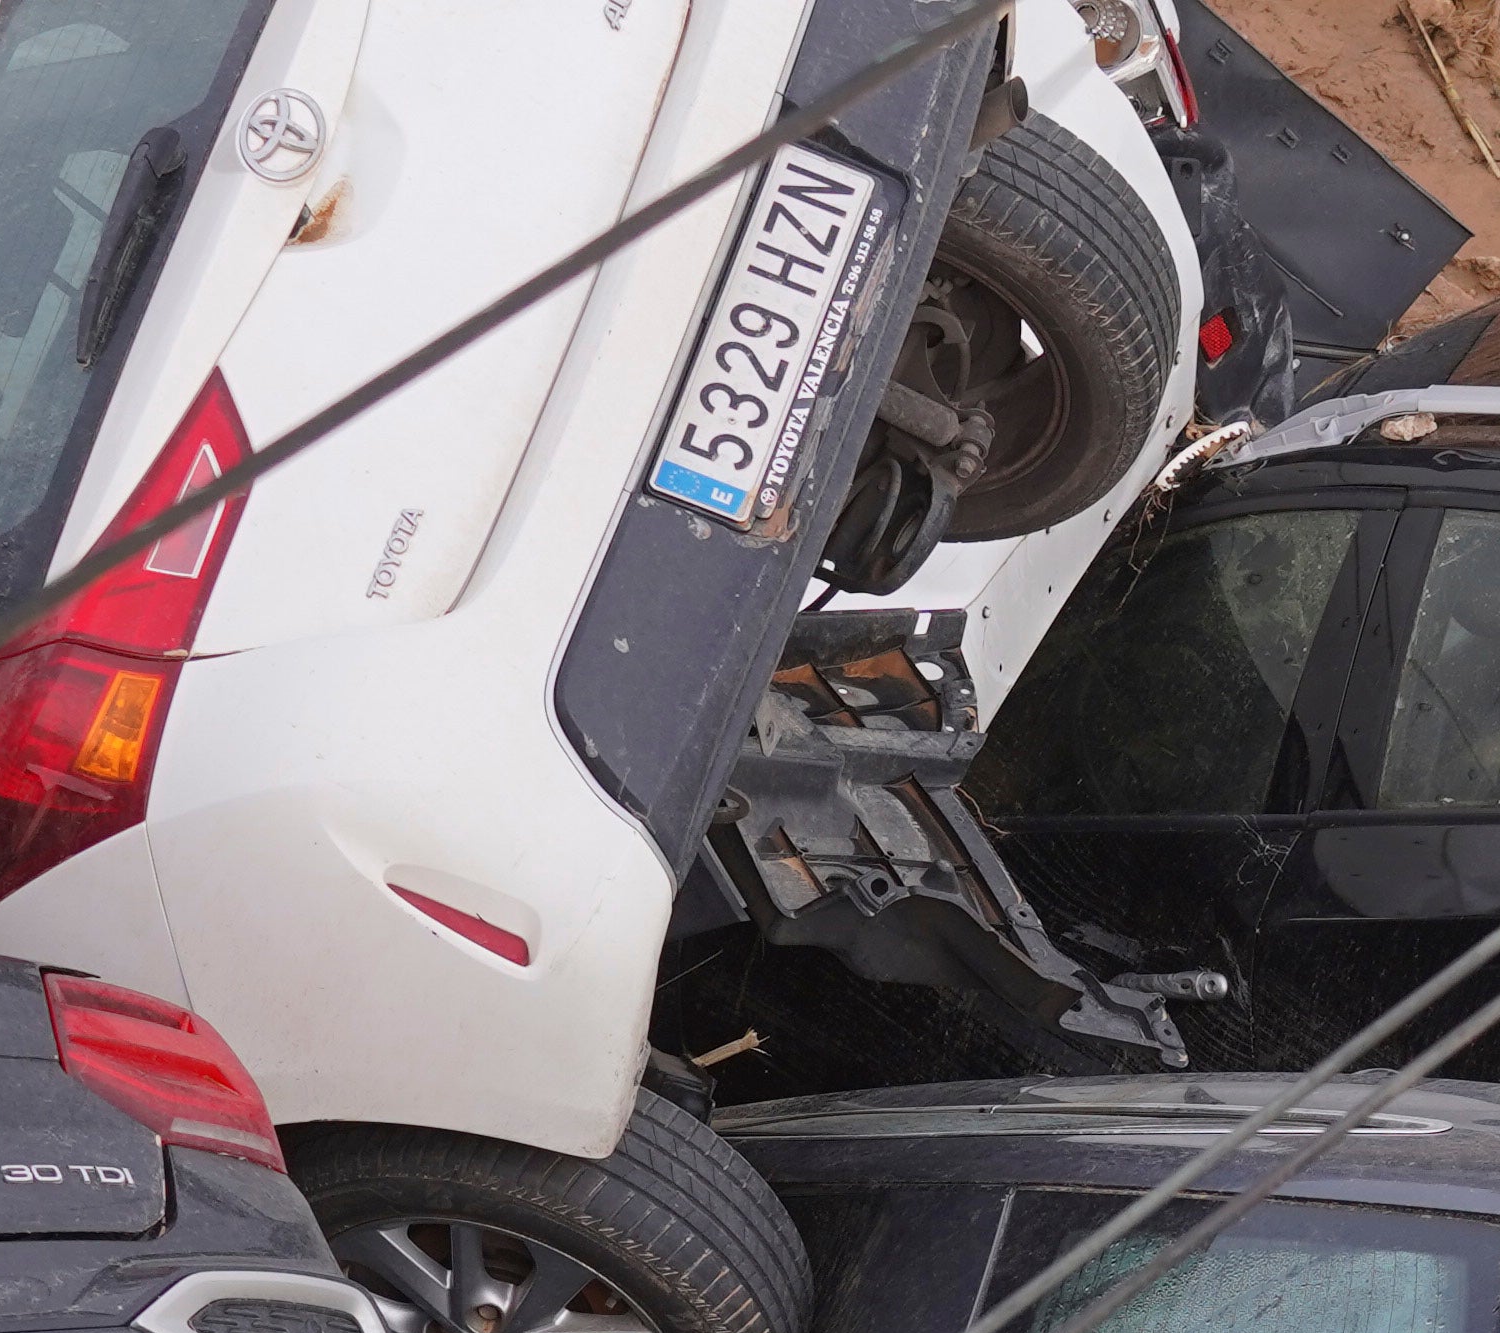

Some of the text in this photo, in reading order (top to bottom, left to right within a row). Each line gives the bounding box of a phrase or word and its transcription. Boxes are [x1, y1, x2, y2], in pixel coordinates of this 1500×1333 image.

[680, 302, 801, 471] 5329
[747, 163, 856, 298] HZN
[766, 406, 810, 486] TOYOTA
[797, 300, 850, 400] VALENCIA
[846, 271, 862, 288] 96
[864, 223, 878, 241] 58
[366, 508, 424, 598] TOYOTA
[0, 1164, 137, 1189] 30 TDI
